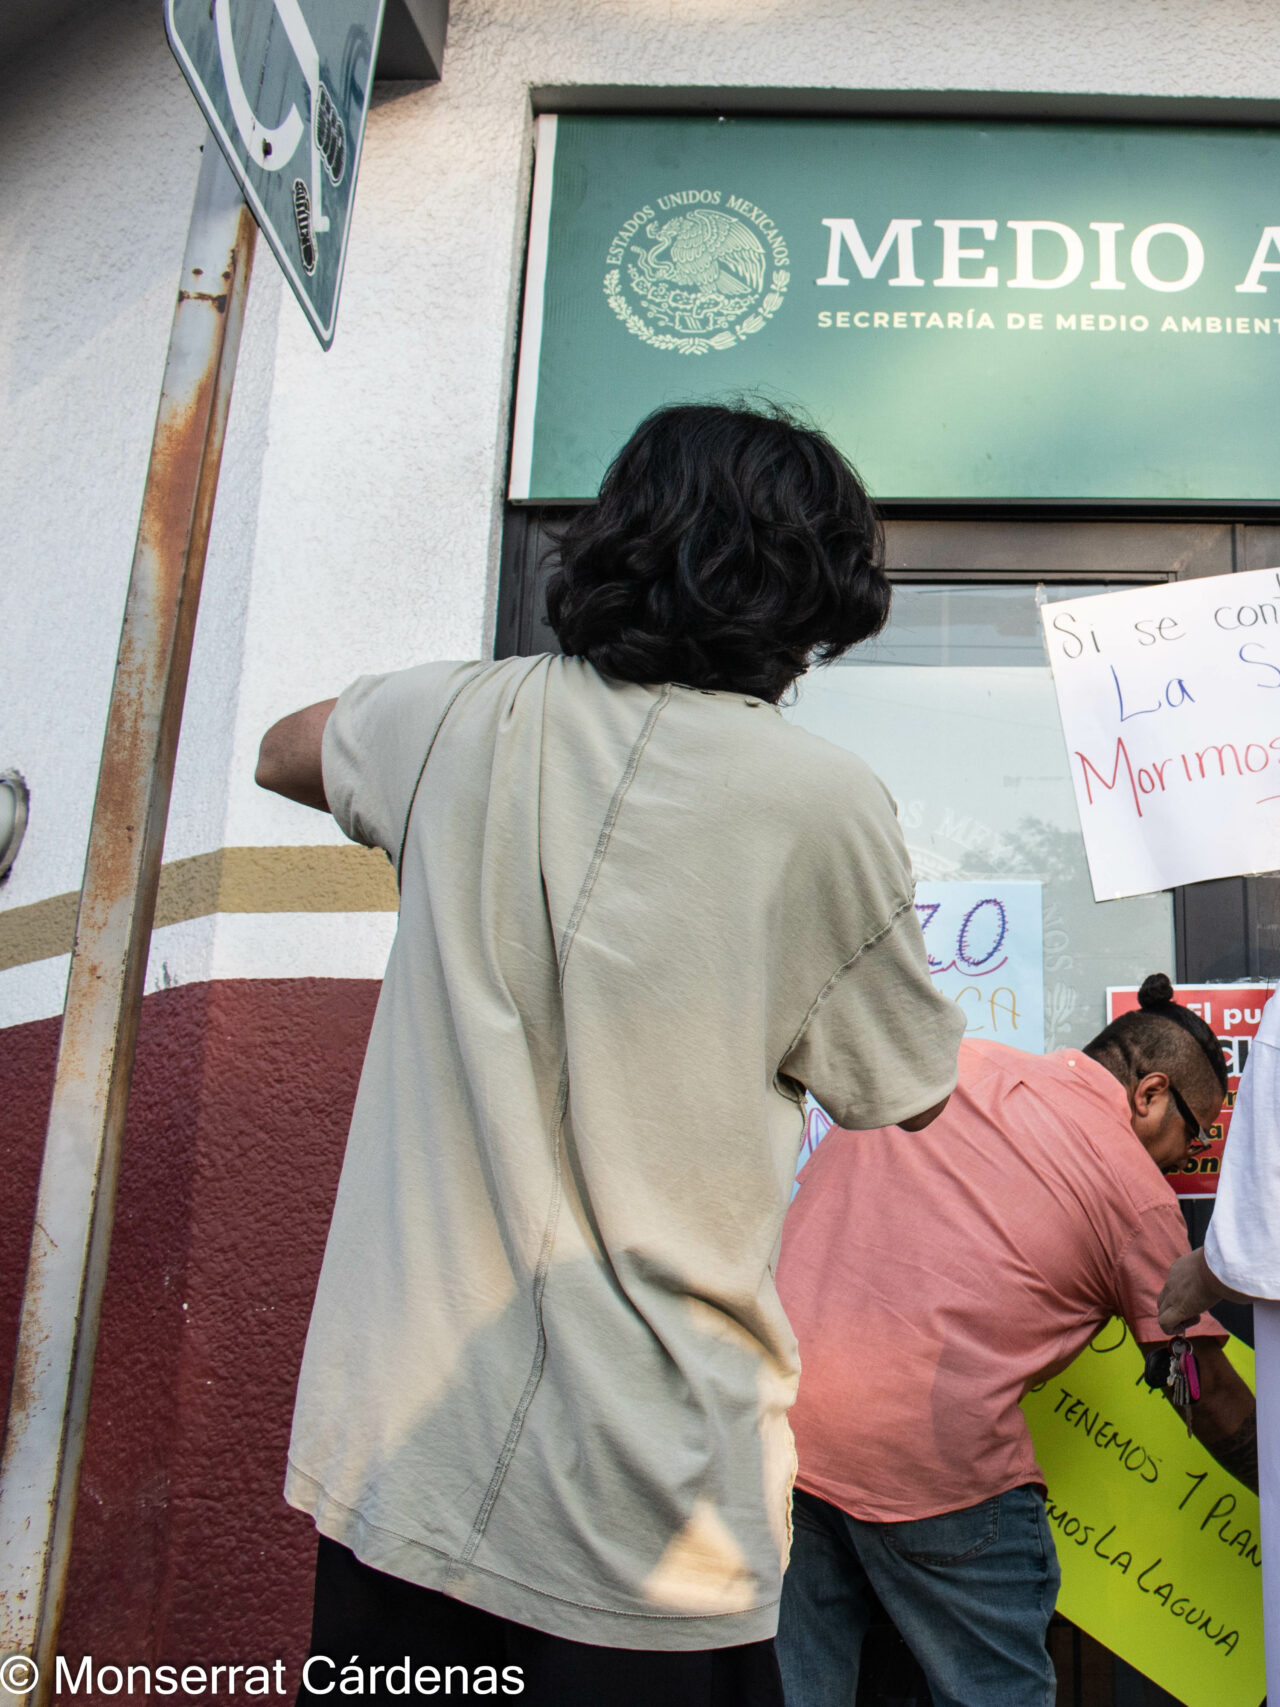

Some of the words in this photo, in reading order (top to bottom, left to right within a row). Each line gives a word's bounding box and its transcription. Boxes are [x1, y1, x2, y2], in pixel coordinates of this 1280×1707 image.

[606, 204, 655, 265] ESTADOS
[657, 189, 722, 210] UNIDOS
[726, 194, 790, 267] MEXICANOS
[815, 218, 1205, 292] MEDIO
[817, 309, 995, 329] SECRETARÍA
[1007, 313, 1044, 330] DE
[1056, 313, 1149, 332] MEDIO
[1053, 612, 1101, 659] Si
[1135, 616, 1186, 646] se
[1110, 664, 1196, 722] La
[1053, 1388, 1163, 1483] TENEMOS
[1094, 1525, 1133, 1575] LA
[1137, 1557, 1240, 1657] LAGUNA
